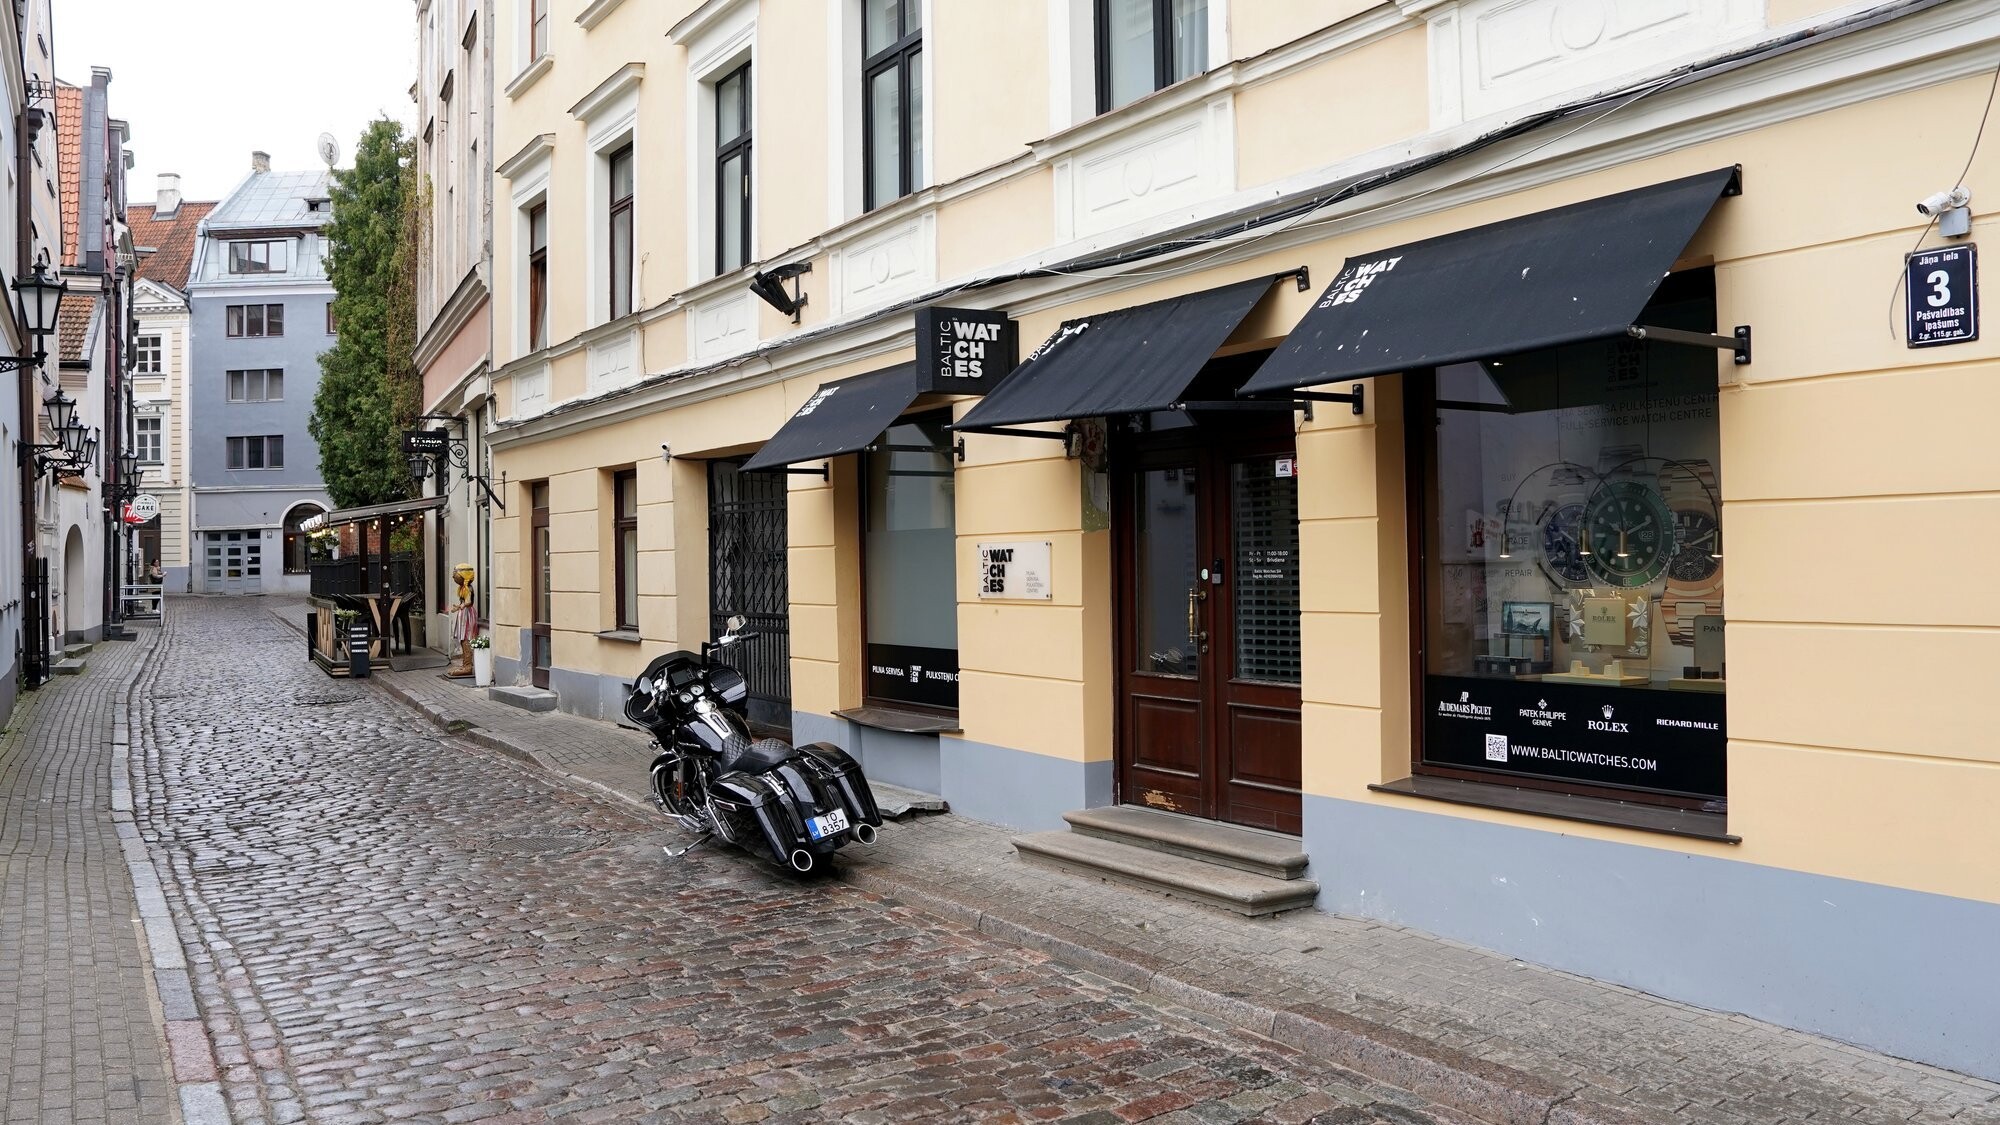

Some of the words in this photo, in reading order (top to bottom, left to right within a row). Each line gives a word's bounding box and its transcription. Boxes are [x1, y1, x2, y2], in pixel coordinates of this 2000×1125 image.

[1919, 256, 1938, 265] Jāņa
[1943, 252, 1958, 262] iela
[1355, 256, 1403, 278] WAT
[1319, 268, 1355, 308] BALTIC
[1344, 274, 1376, 292] CH
[1927, 270, 1951, 307] 3
[1332, 289, 1363, 306] ES
[954, 322, 1000, 341] WAT
[940, 321, 952, 376] BALTIC
[954, 341, 984, 359] CH
[955, 360, 982, 378] ES
[1630, 412, 1666, 424] WATCH
[1669, 408, 1712, 421] CENTRE
[1508, 536, 1528, 545] RADE
[989, 549, 1014, 562] WAT
[990, 564, 1005, 578] CH
[1504, 569, 1533, 577] REPAIR
[990, 579, 1004, 592] ES
[872, 666, 885, 674] PILNA
[886, 667, 904, 676] SERVISA
[1438, 701, 1470, 713] AUDEMARS
[1470, 704, 1492, 715] PIGUET
[1519, 709, 1538, 718] PATEK
[1539, 710, 1567, 720] PHILIPPE
[1587, 720, 1629, 733] ROLEX
[1656, 718, 1692, 728] RICHARD
[1693, 721, 1719, 730] MILLE
[1510, 745, 1656, 771] WWW.BALTICWATCHES.COM
[823, 813, 837, 824] TO
[822, 819, 844, 835] 8357
